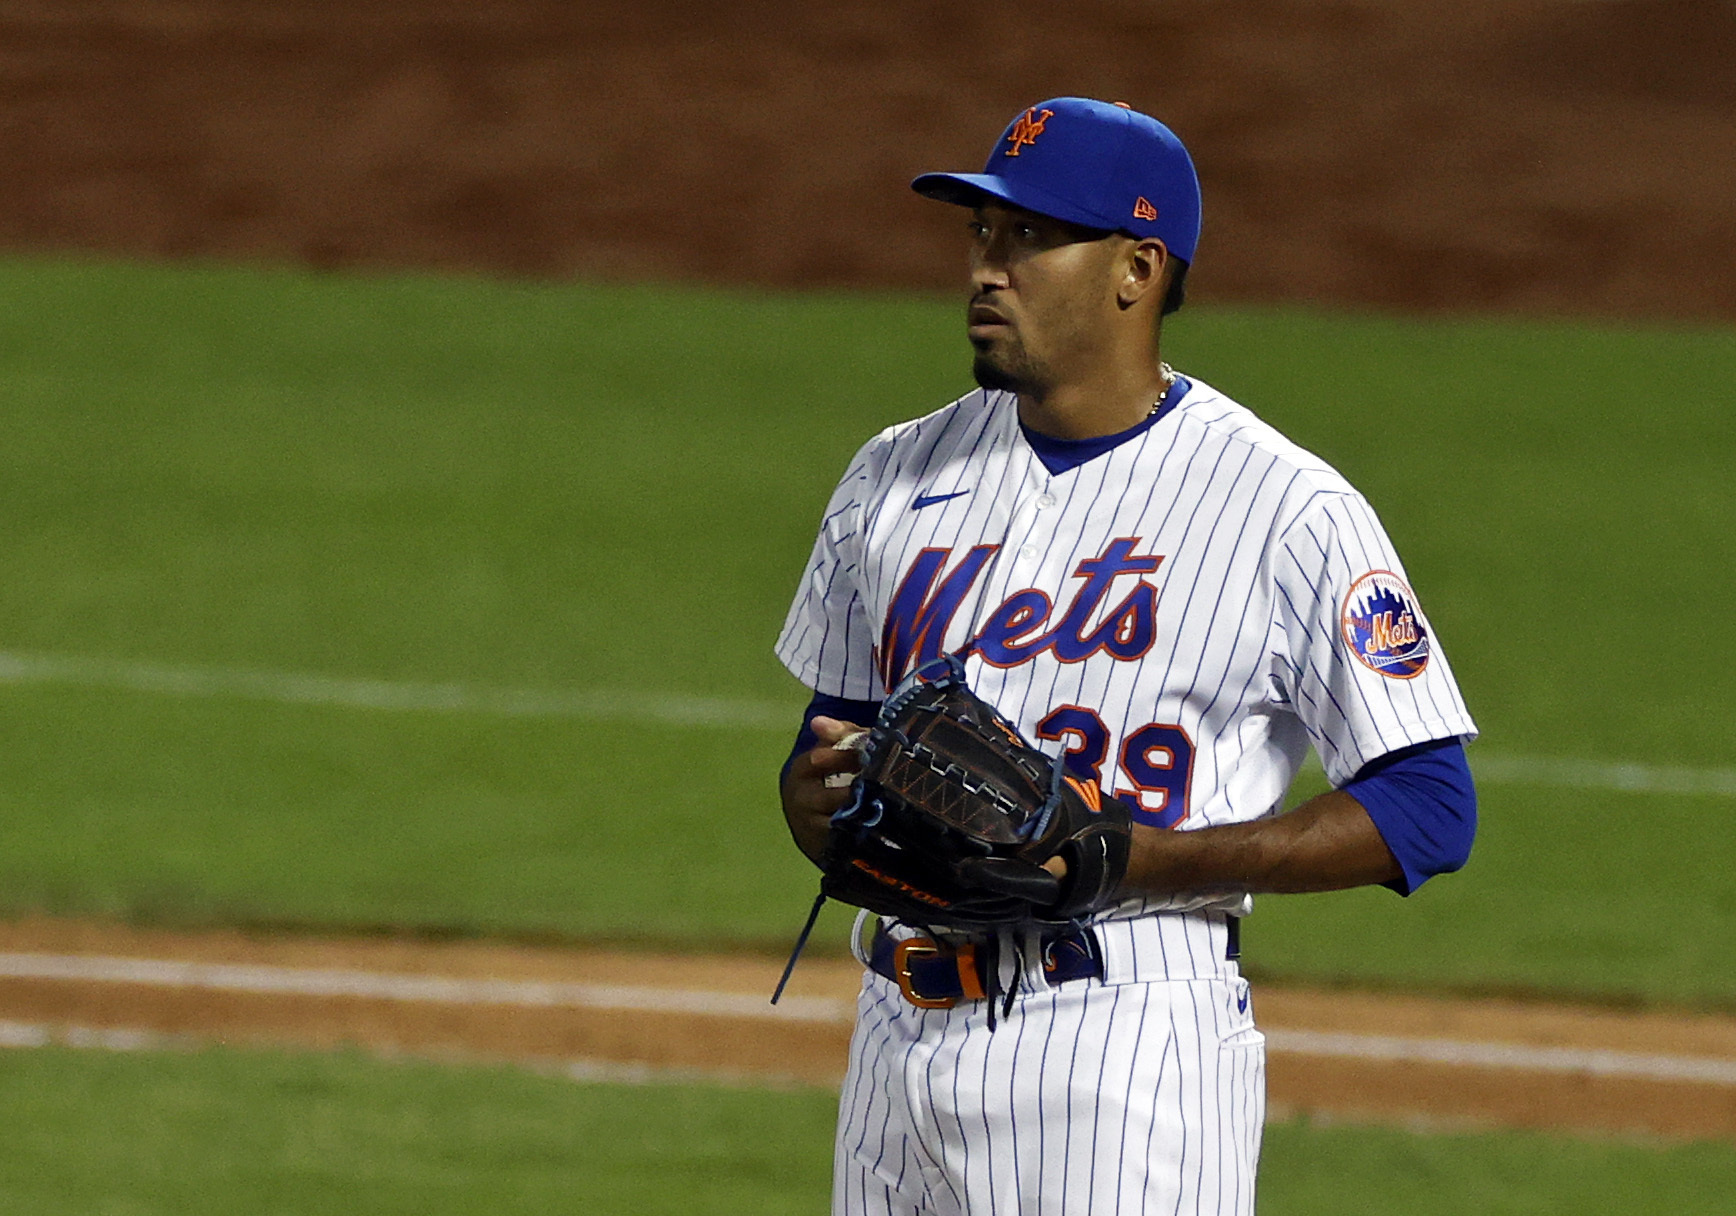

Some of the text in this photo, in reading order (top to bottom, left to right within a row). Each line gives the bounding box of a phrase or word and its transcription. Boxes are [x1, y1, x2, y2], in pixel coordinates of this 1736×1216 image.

[872, 537, 1166, 692] Mets
[1365, 610, 1418, 654] Mets
[1036, 703, 1196, 829] 39
